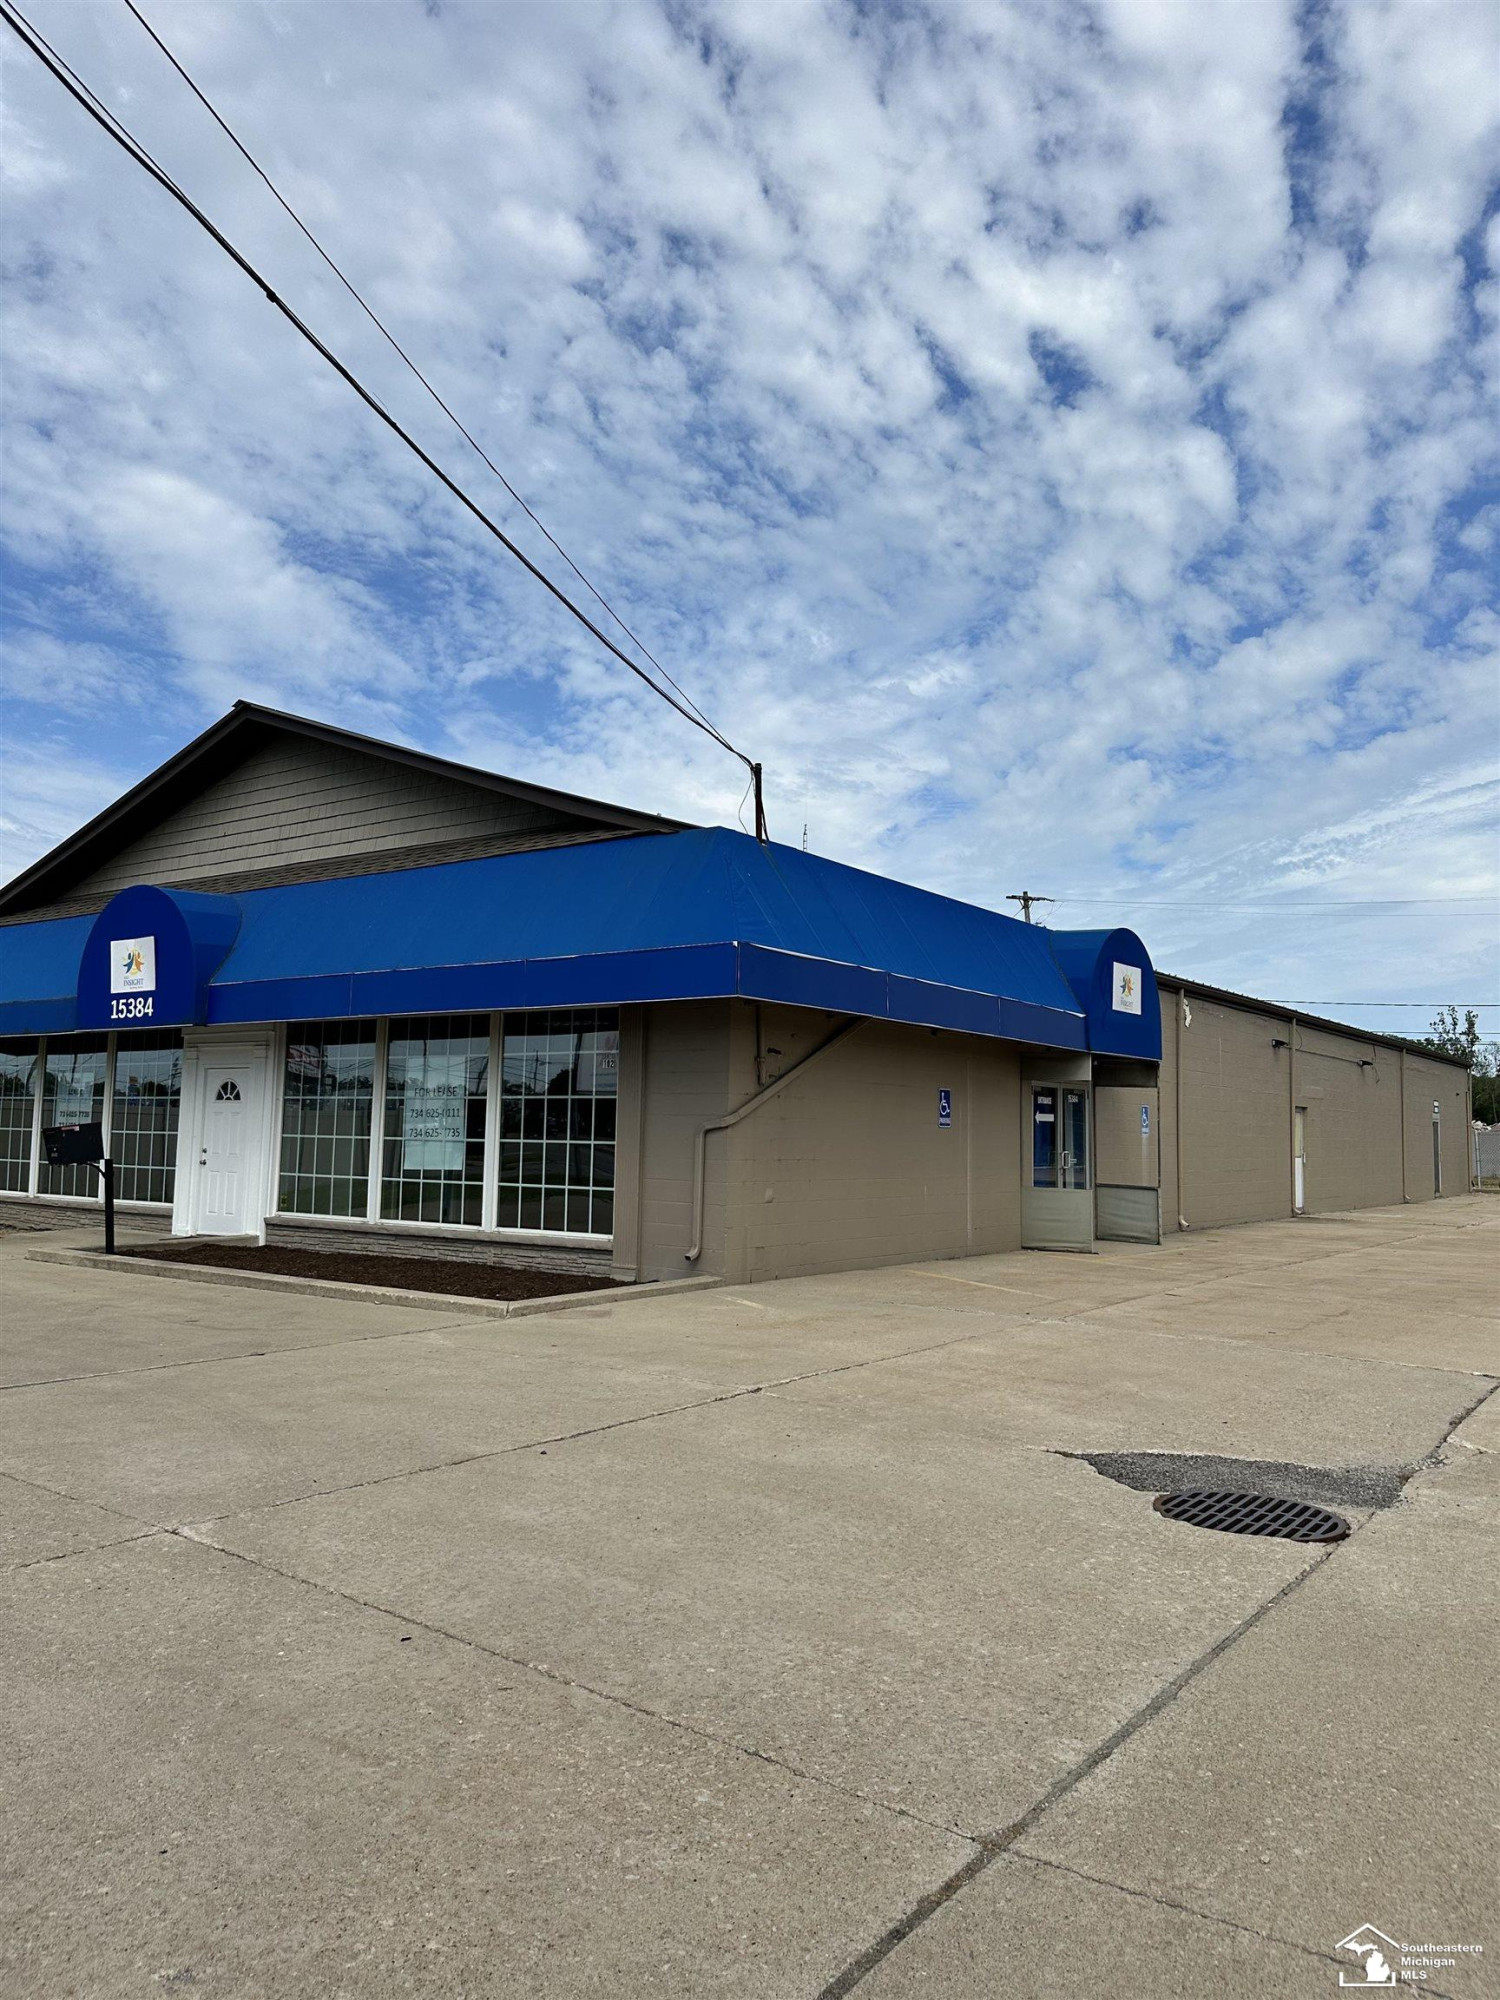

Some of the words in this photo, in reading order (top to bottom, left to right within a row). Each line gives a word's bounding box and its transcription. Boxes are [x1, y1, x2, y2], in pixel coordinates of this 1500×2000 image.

[111, 997, 153, 1018] 15384
[414, 1087, 430, 1097] FOR
[410, 1108, 423, 1118] 734
[409, 1128, 423, 1138] 734
